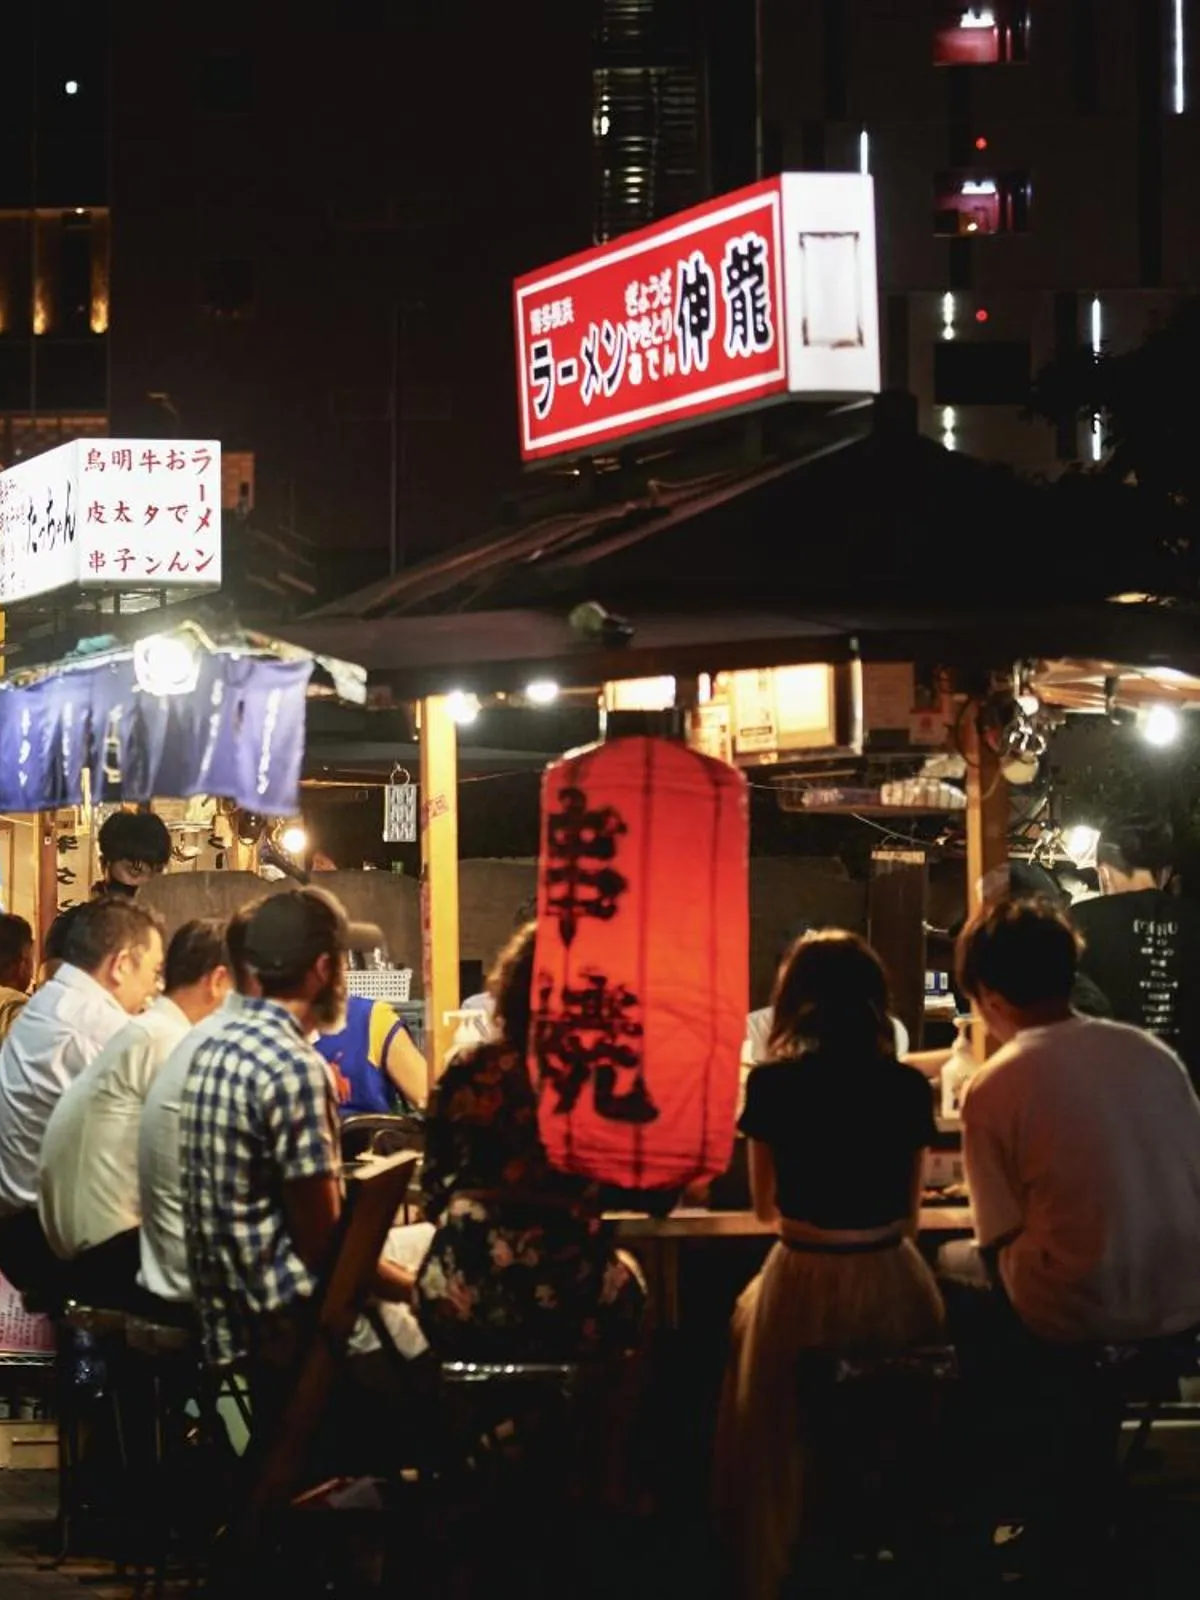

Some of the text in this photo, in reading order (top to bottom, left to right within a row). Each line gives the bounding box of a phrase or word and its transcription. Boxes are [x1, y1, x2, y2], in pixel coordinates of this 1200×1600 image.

[675, 231, 775, 375] 伸龍
[531, 320, 627, 419] ラーメン
[111, 449, 136, 572] 明太子
[140, 449, 163, 575] 牛タン
[165, 449, 190, 572] おでん
[191, 448, 214, 573] ラーメン
